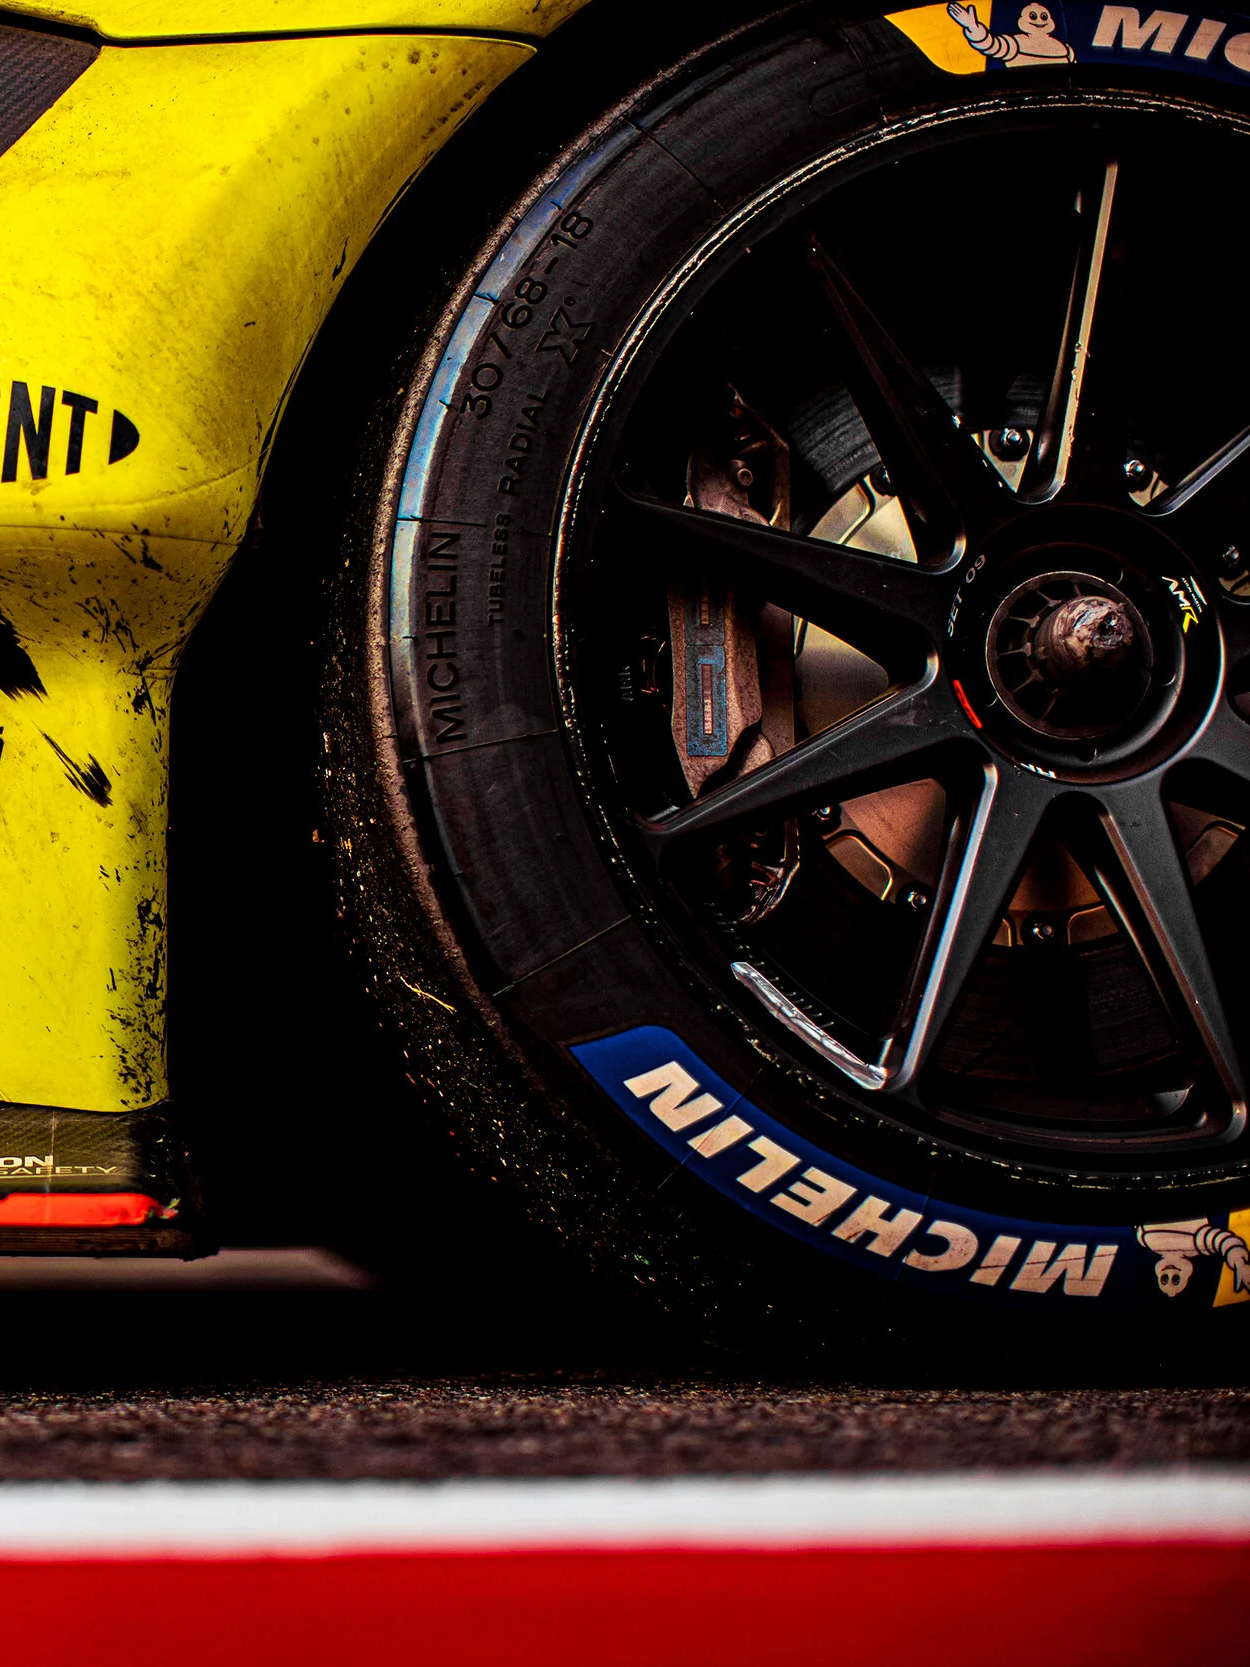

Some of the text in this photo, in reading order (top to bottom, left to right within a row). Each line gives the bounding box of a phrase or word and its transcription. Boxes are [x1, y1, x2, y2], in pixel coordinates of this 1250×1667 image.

[488, 389, 551, 627] TUBELESS RADIAL
[947, 587, 963, 638] SET
[1161, 575, 1199, 634] AMR
[425, 532, 467, 744] MICHELIN
[622, 1060, 1120, 1298] MICHELIN
